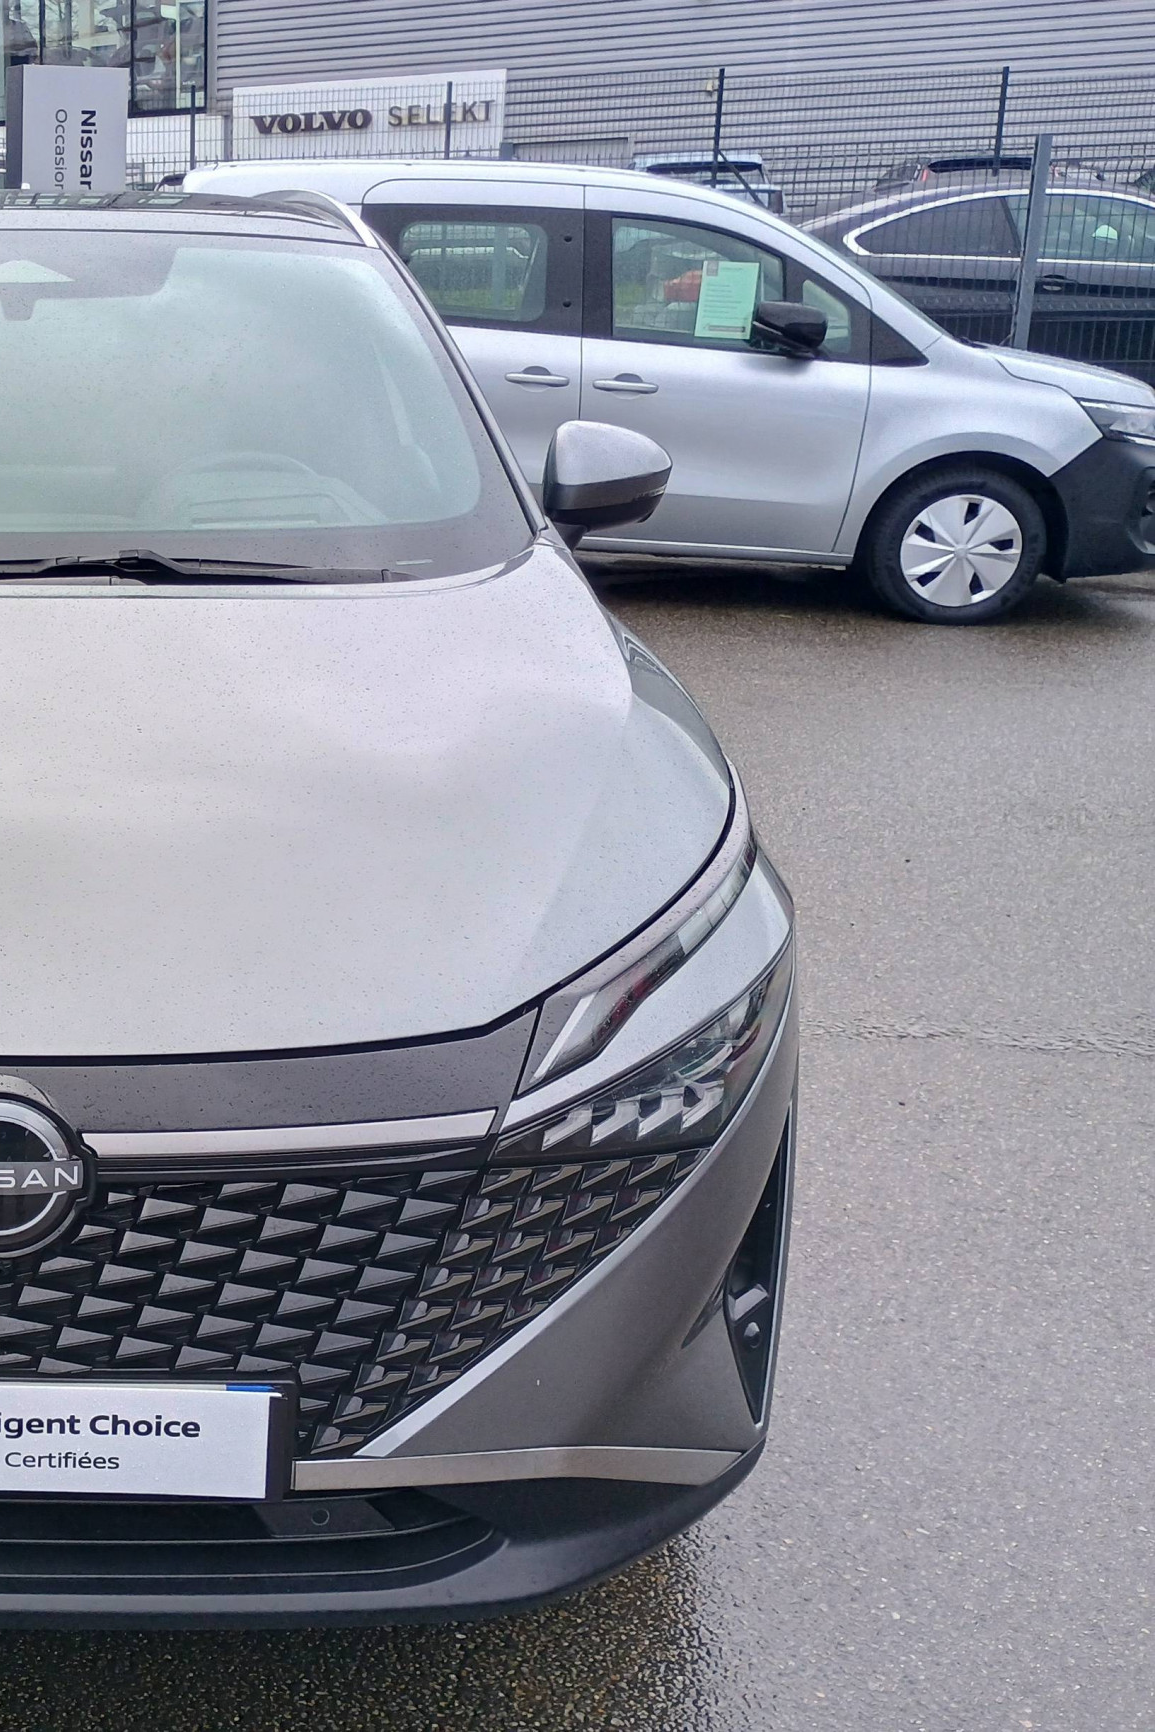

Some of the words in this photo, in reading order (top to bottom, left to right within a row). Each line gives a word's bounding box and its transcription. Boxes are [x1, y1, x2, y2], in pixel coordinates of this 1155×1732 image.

[249, 108, 372, 134] VOLVO
[89, 1414, 201, 1438] Choice
[4, 1450, 120, 1470] Certifiées
